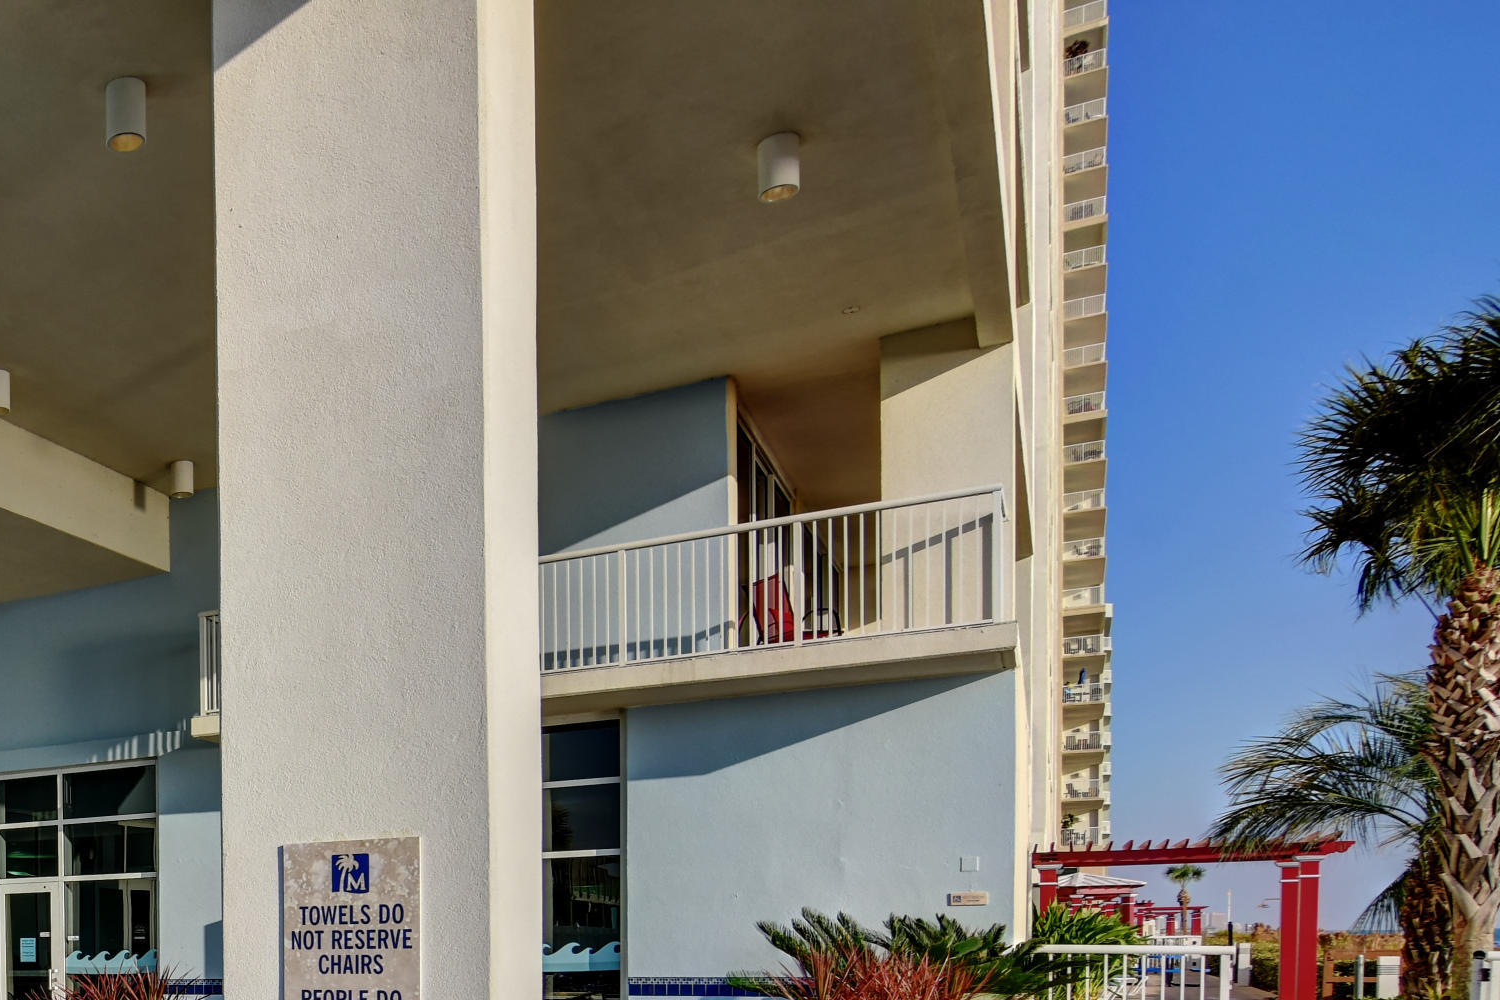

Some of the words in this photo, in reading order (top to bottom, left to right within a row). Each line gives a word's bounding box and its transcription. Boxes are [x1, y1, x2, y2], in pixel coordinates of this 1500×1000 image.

[299, 904, 371, 926] TOWELS
[378, 903, 405, 924] DO
[291, 930, 324, 950] NOT
[331, 928, 413, 950] RESERVE
[318, 954, 384, 975] CHAIRS
